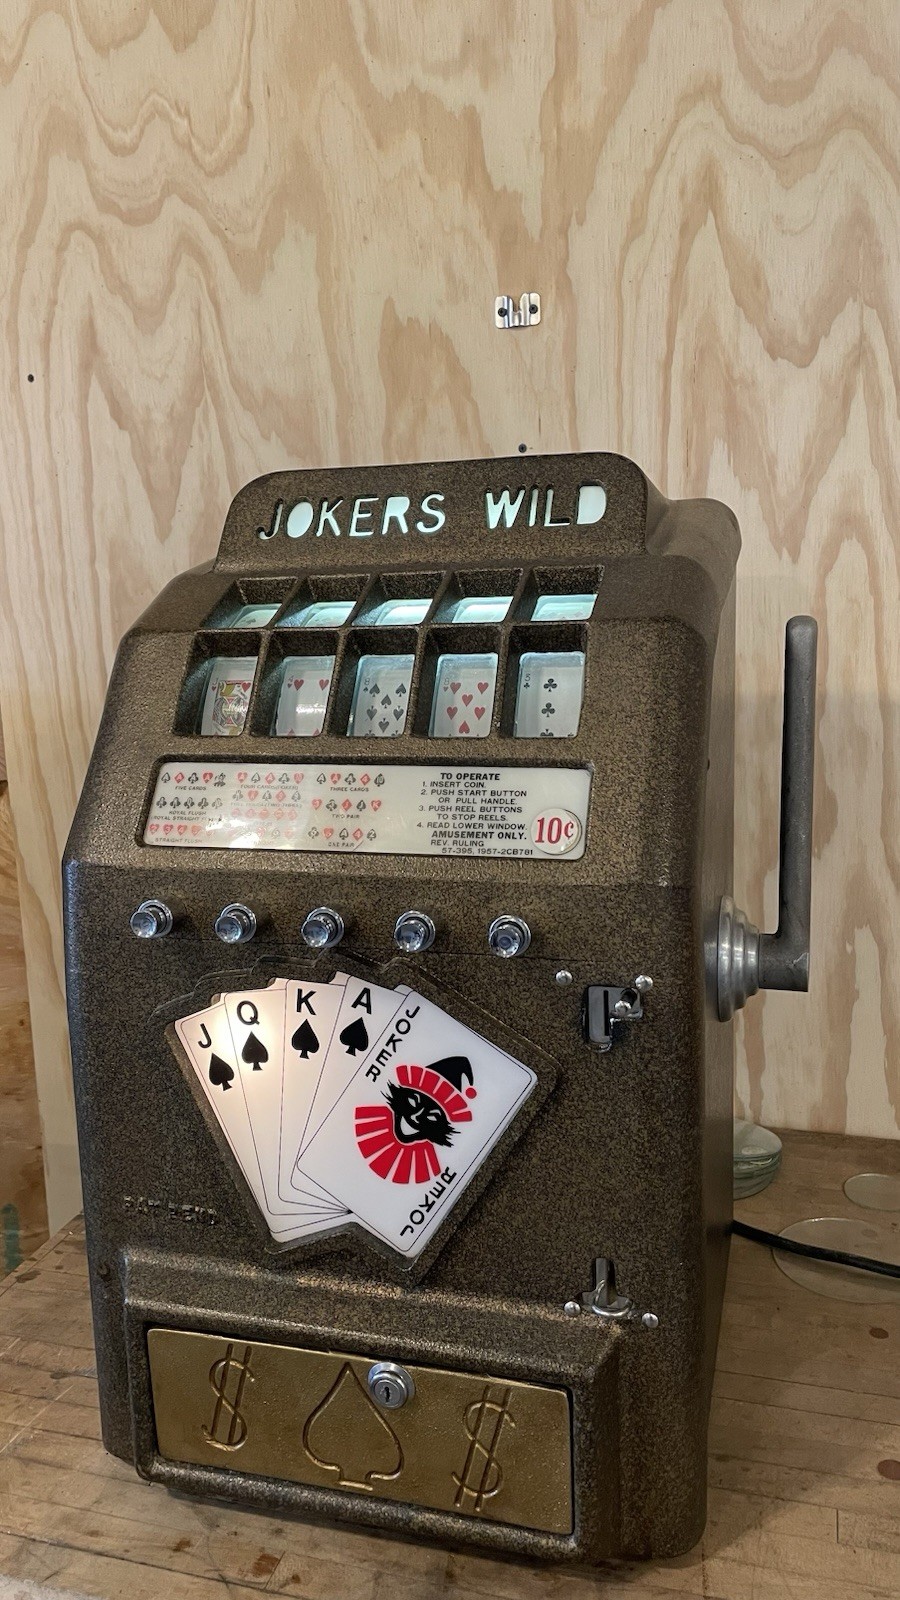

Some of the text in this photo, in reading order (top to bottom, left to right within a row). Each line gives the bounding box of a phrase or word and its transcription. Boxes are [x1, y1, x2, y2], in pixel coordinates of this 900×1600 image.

[257, 482, 607, 540] JOKERS WILD
[363, 678, 370, 686] 8
[524, 673, 531, 682] 5
[431, 831, 527, 840] AMUSEMENT ONLY.
[534, 817, 574, 844] 10¢
[441, 847, 475, 855] 57-395,
[236, 1000, 260, 1025] Q
[296, 988, 316, 1016] K
[351, 987, 372, 1015] A
[197, 1023, 212, 1048] J
[365, 1005, 421, 1082] JOKER
[400, 1166, 457, 1237] JOKER
